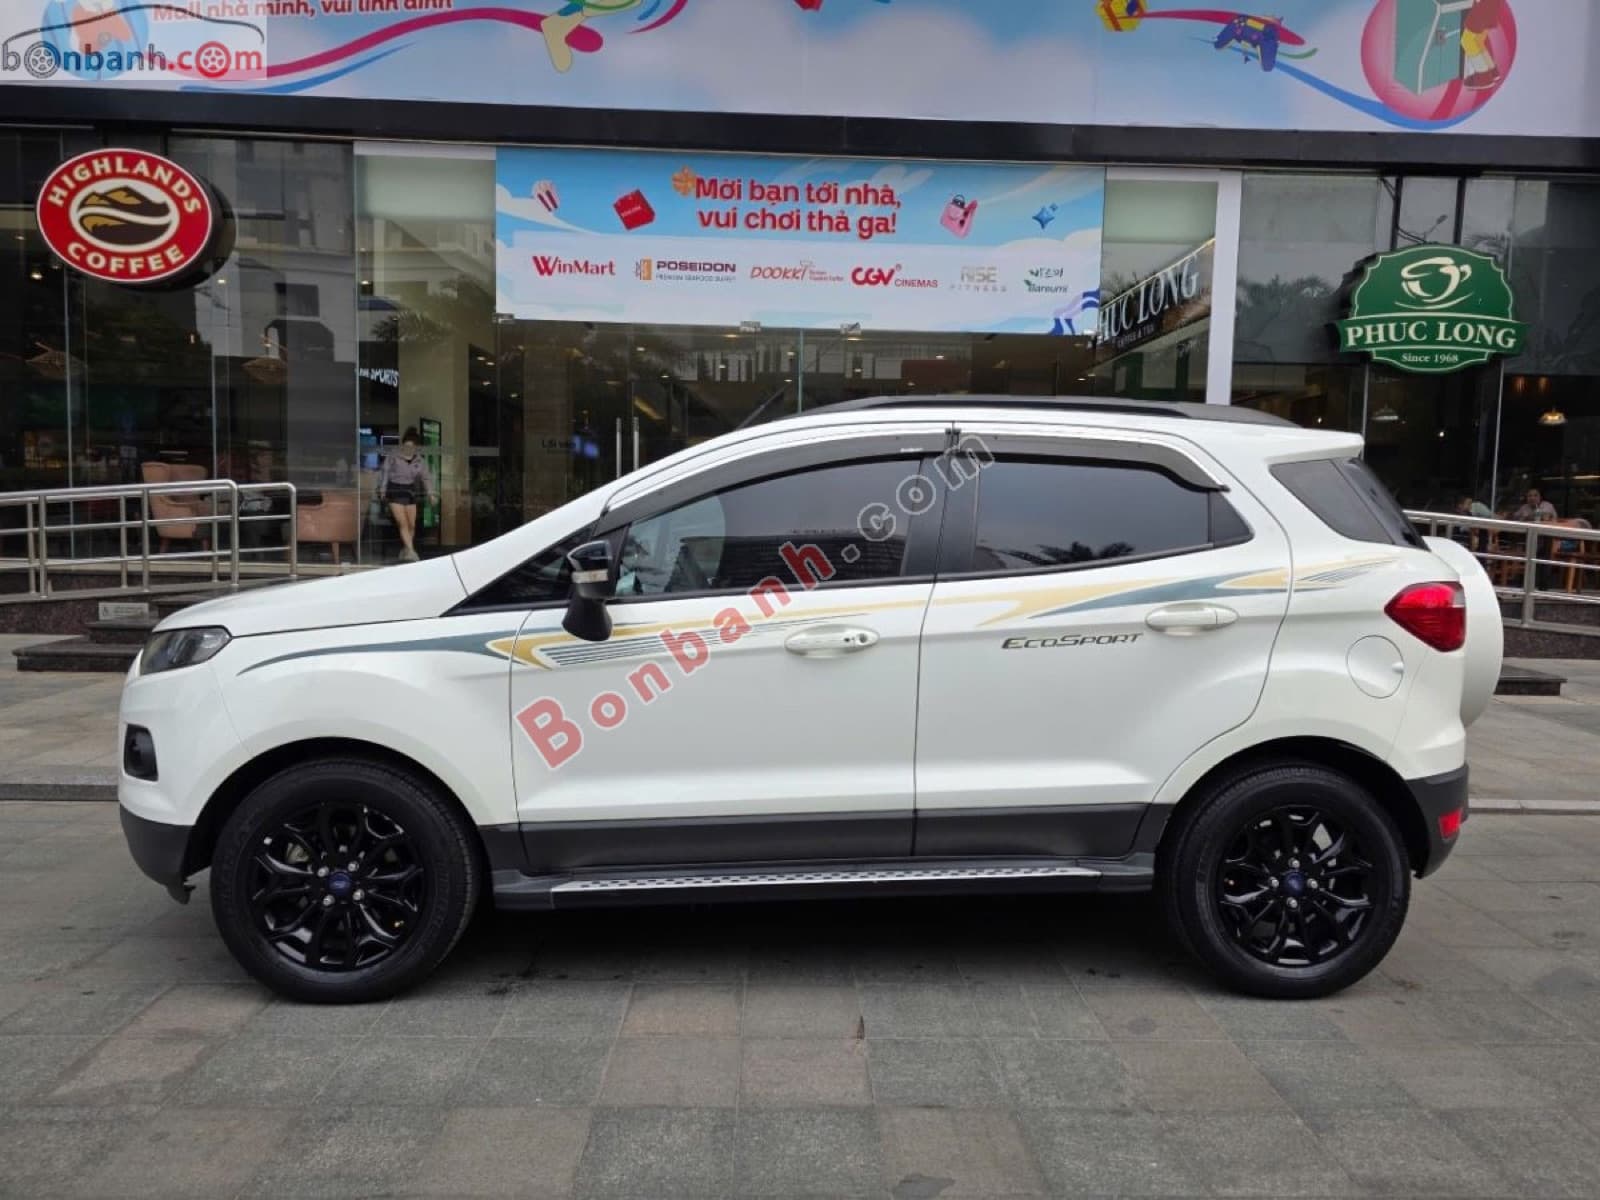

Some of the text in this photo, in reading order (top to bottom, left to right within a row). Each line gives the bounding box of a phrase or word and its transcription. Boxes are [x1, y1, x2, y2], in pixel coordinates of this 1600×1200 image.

[153, 2, 201, 20] Mall
[48, 156, 202, 214] HIGHLANDS
[695, 177, 743, 200] Mời
[749, 179, 799, 206] bạn
[805, 181, 839, 204] tới
[698, 207, 897, 240] vui chơi thả ga!
[67, 240, 185, 275] COFFEE
[532, 256, 616, 277] WinMart
[656, 260, 736, 273] POSEIDON
[750, 265, 806, 281] DOOKKI
[851, 267, 896, 286] CGV
[894, 278, 939, 289] CINEMAS
[1097, 252, 1199, 343] HUC LONG
[1345, 320, 1518, 348] PHUC LONG
[1401, 352, 1459, 364] Since 1968
